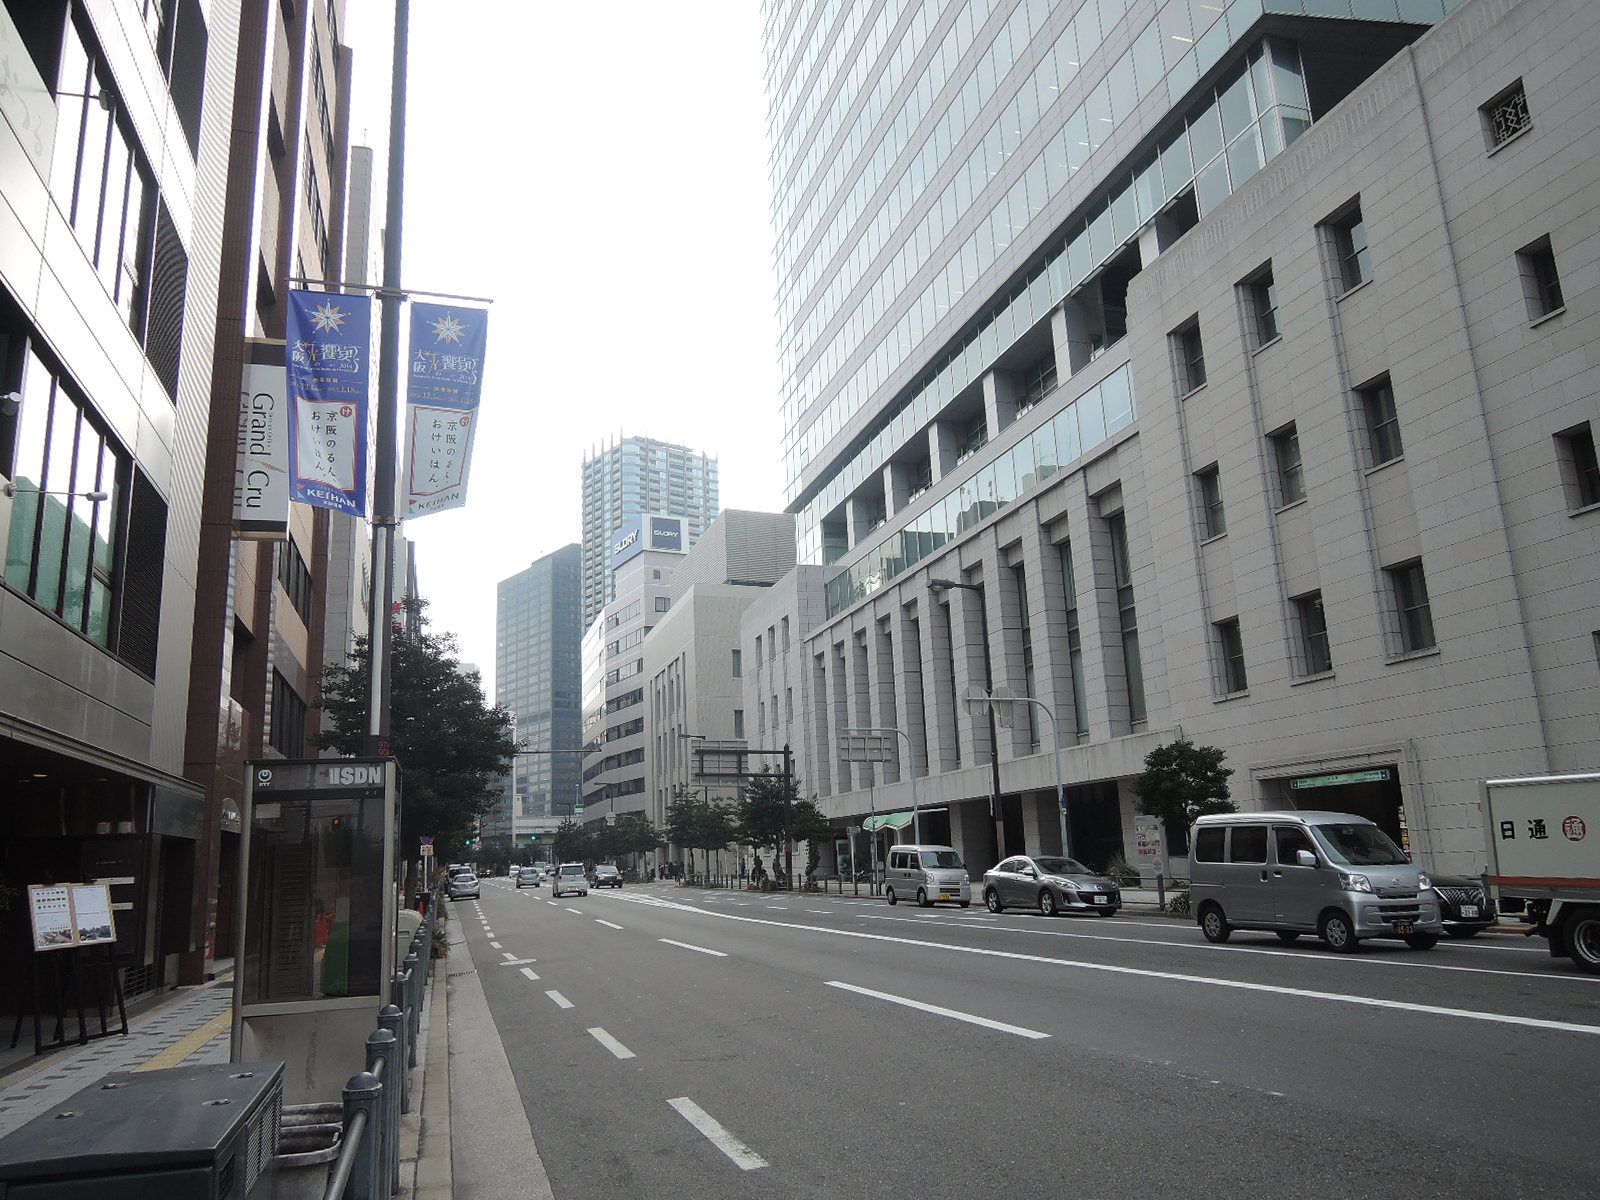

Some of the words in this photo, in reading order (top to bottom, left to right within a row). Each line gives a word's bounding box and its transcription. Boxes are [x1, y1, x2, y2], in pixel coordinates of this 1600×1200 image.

[249, 393, 275, 456] Grand
[246, 470, 270, 508] Cru
[307, 488, 356, 508] KEIHAN
[418, 493, 459, 509] KEIHAN
[613, 528, 639, 555] GLORY
[653, 529, 679, 538] GLORY
